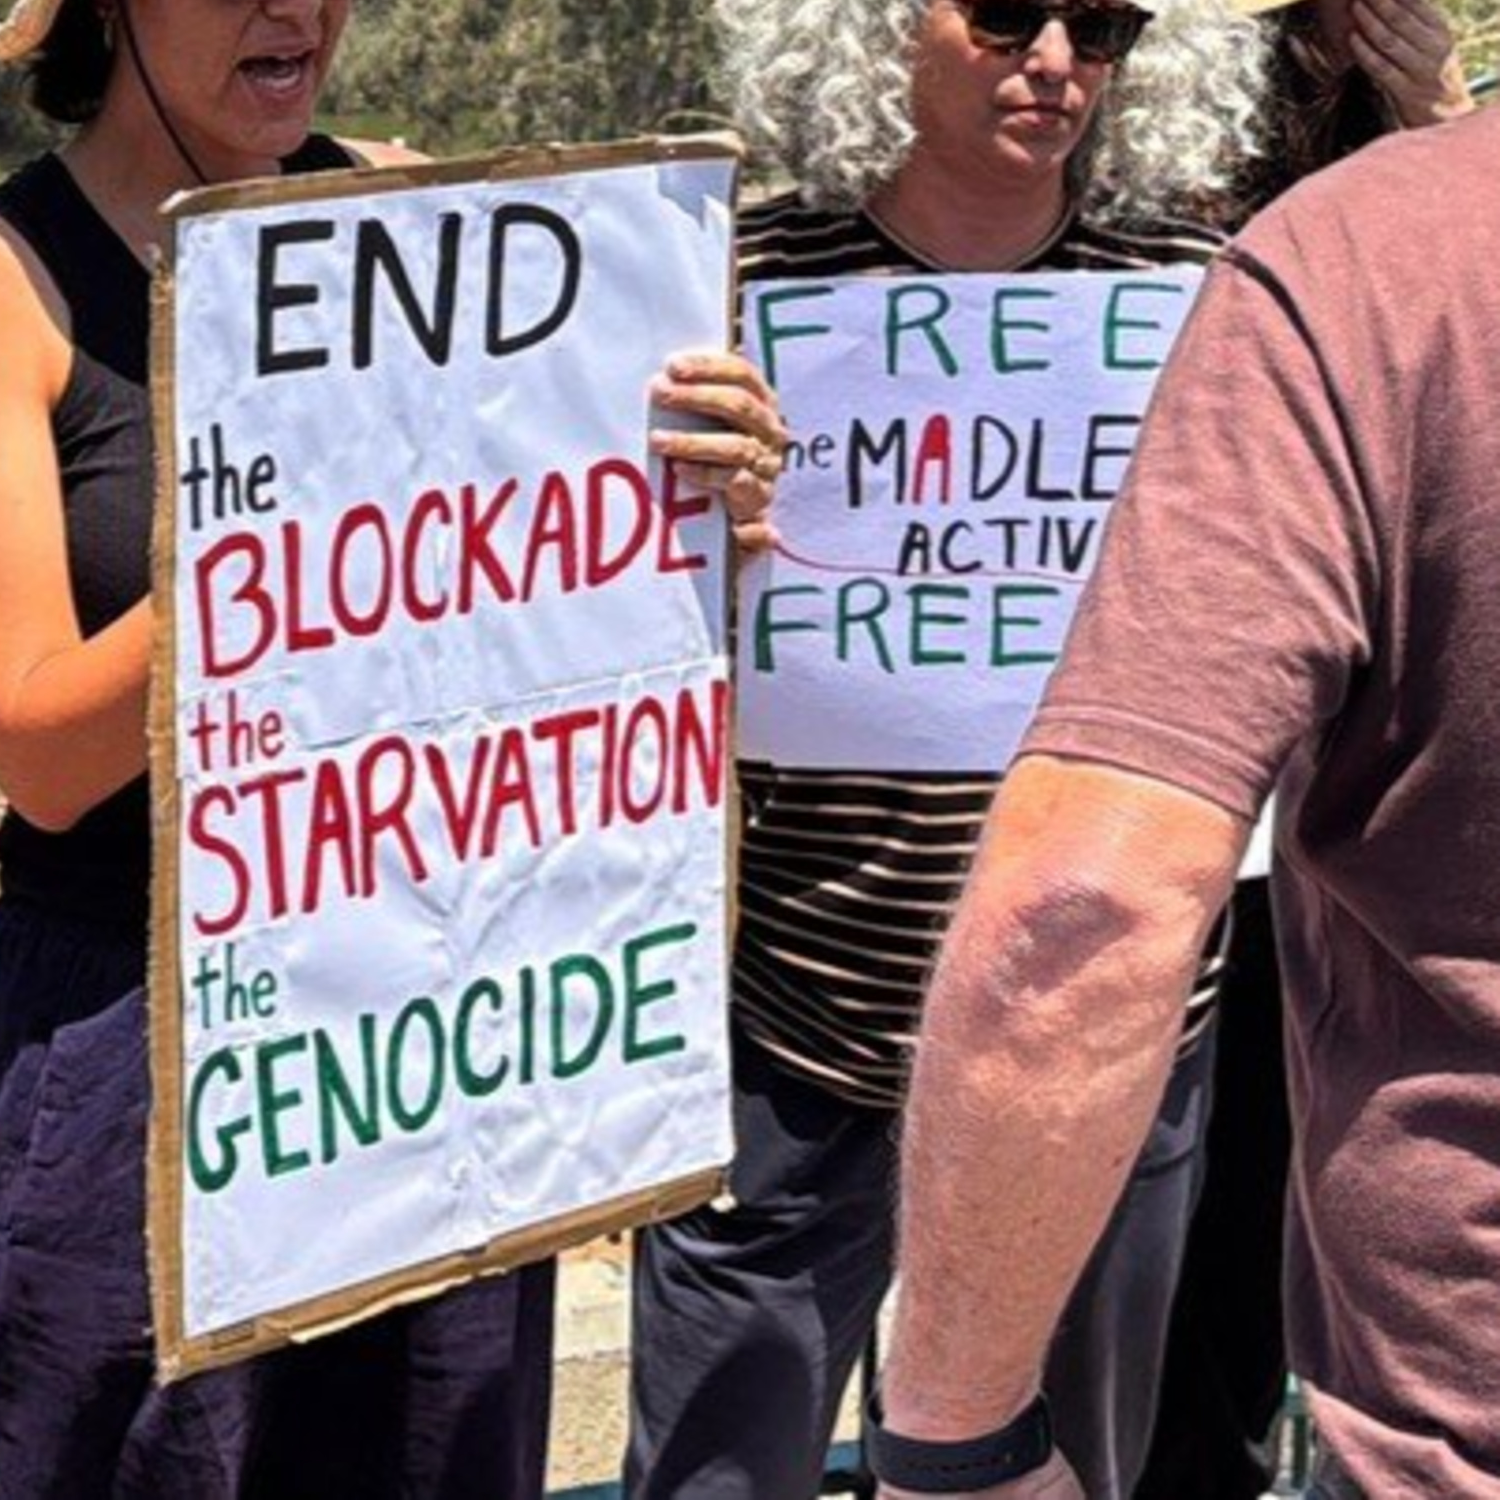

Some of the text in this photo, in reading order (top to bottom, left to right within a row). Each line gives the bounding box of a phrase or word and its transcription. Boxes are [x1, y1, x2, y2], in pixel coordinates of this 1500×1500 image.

[256, 202, 582, 376] END
[755, 283, 1184, 392] FREE
[181, 423, 277, 531] the
[780, 414, 836, 472] he
[193, 457, 712, 679] BLOCKADE
[898, 516, 1097, 577] ACTIV
[754, 577, 1061, 674] FREE
[189, 689, 286, 772] the
[187, 679, 729, 937] STARVATION
[191, 942, 278, 1030] the
[186, 921, 698, 1193] GENOCIDE
